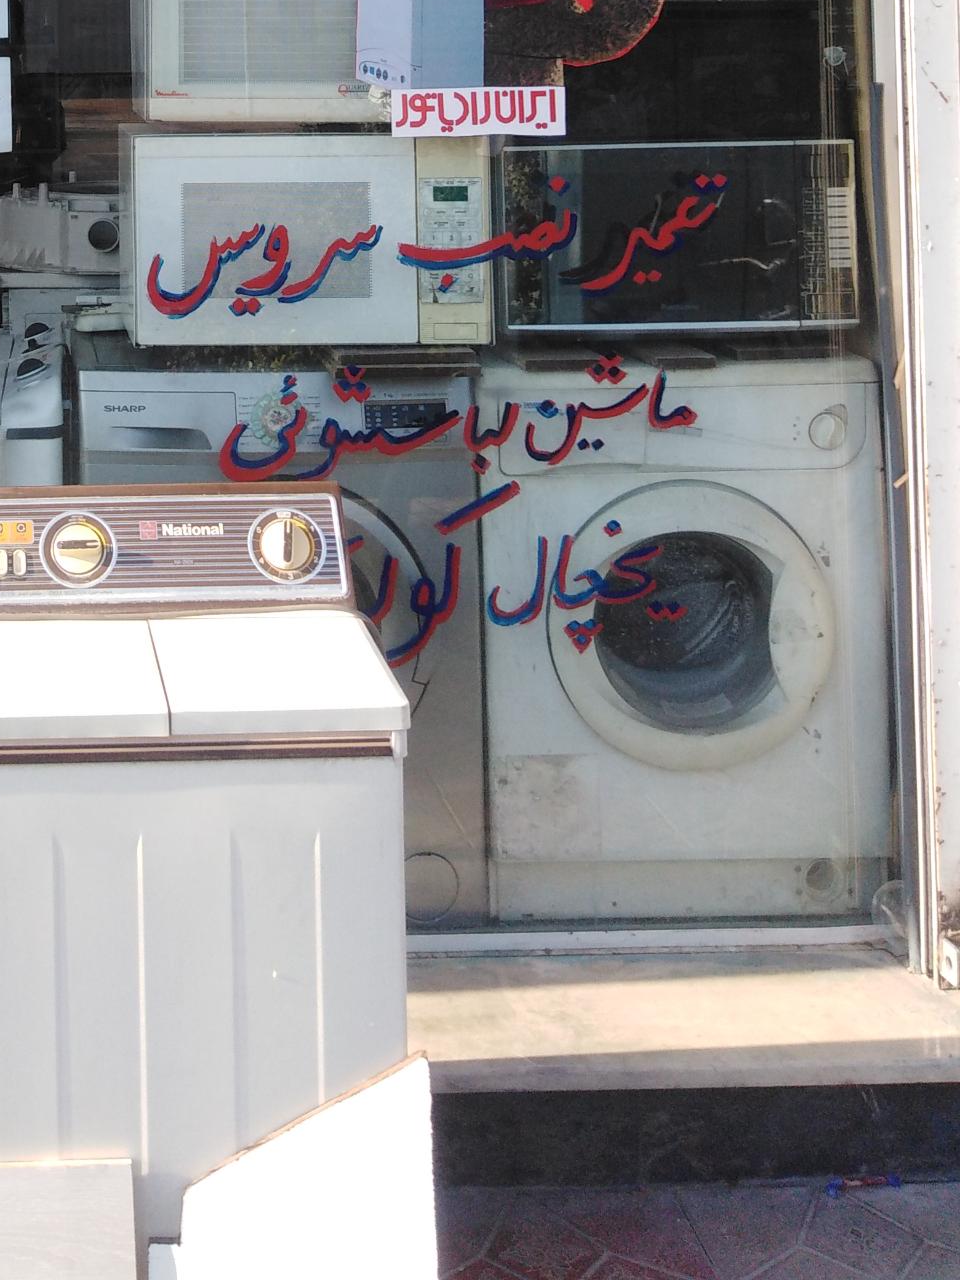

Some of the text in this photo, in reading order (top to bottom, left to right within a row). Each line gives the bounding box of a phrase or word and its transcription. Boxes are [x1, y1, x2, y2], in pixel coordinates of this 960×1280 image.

[396, 89, 557, 132] ایران رادیاتور
[147, 173, 729, 319] تعمیر نصب سرویس
[104, 405, 146, 413] SHARP
[526, 354, 697, 465] ماشین
[161, 523, 224, 537] National
[488, 520, 687, 654] یخچال
